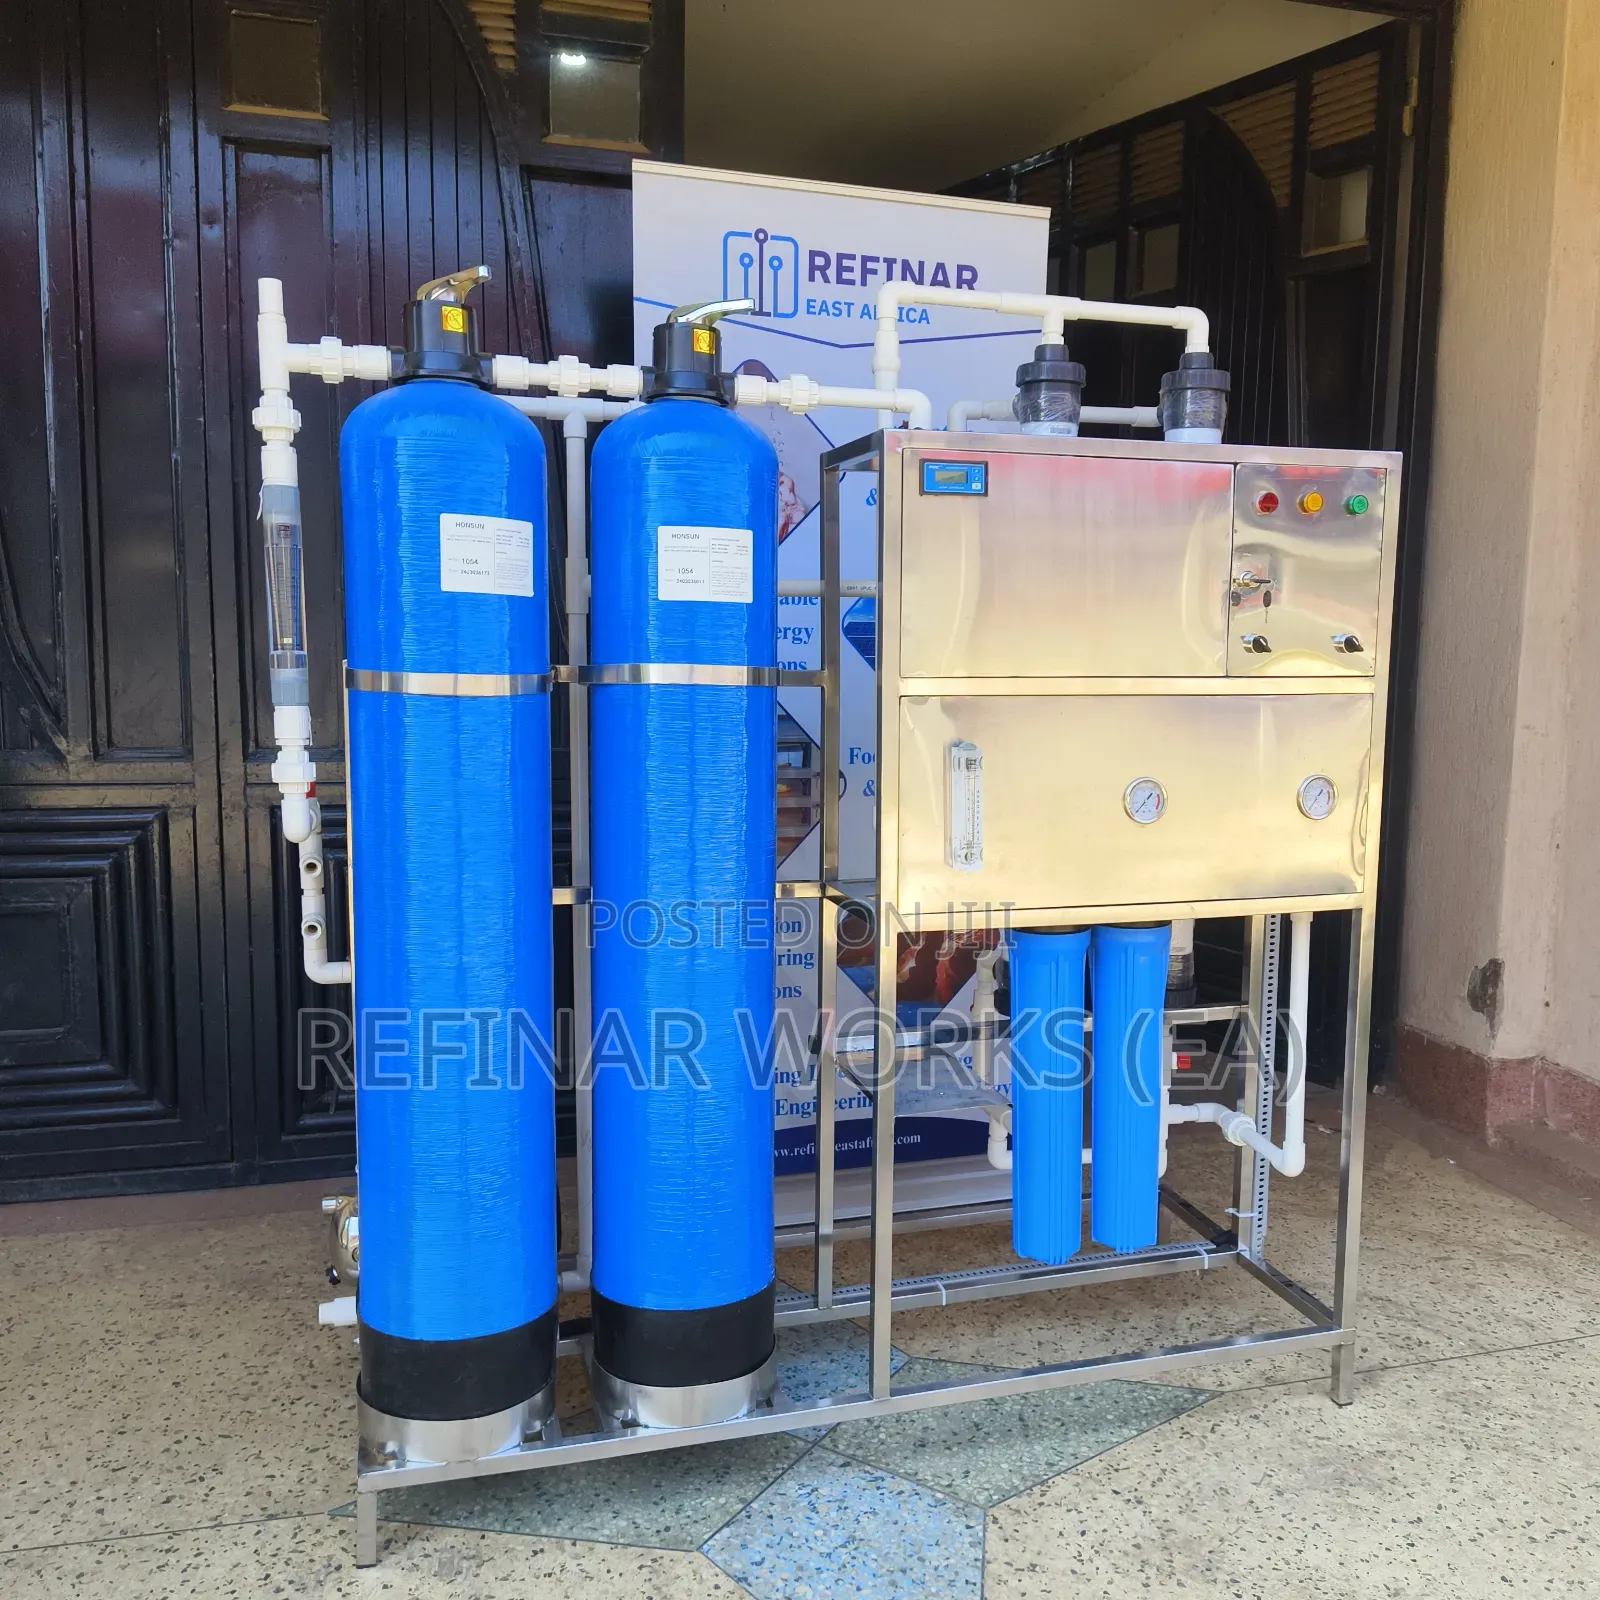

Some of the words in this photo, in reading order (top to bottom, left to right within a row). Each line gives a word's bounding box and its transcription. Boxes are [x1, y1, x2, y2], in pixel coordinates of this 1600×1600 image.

[808, 249, 979, 291] REFINAR
[806, 298, 855, 318] EAST
[860, 302, 931, 325] AICA
[455, 521, 485, 530] HONSUN
[461, 557, 479, 565] 1054
[677, 567, 694, 575] 1054
